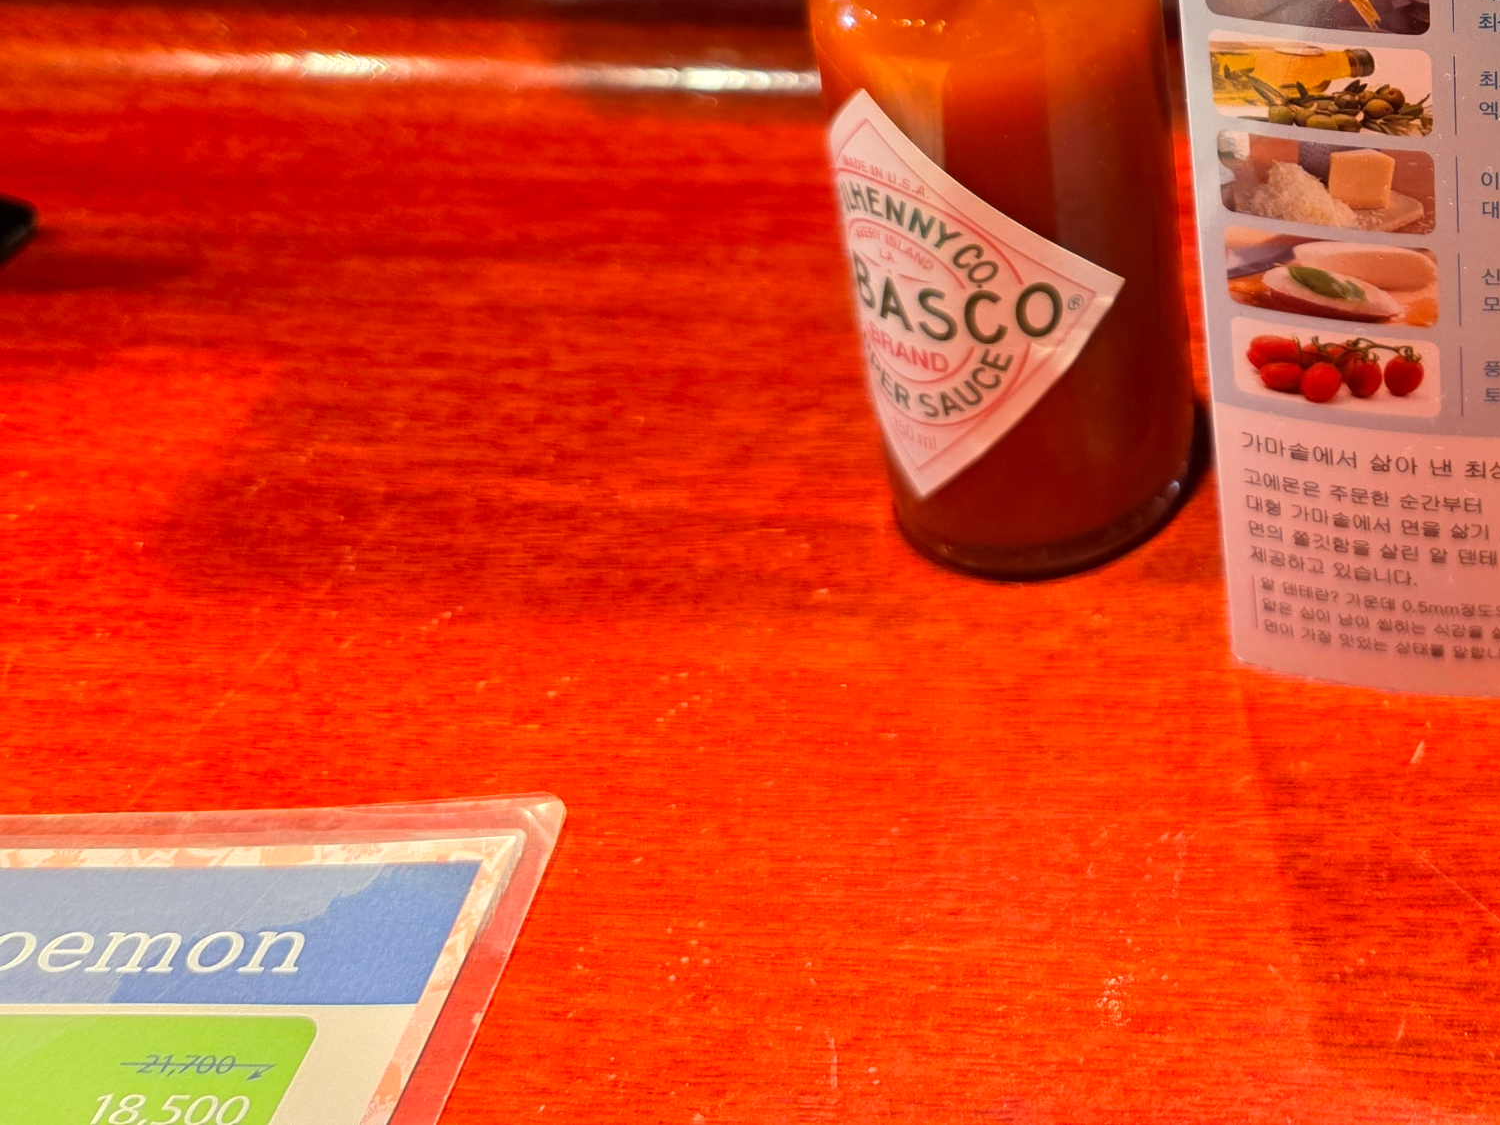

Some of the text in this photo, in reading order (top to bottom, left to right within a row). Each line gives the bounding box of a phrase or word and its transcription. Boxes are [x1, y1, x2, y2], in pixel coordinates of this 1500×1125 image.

[887, 171, 930, 200] U.S.A.
[952, 242, 999, 289] CO.
[869, 327, 951, 374] BRAND
[918, 347, 1014, 419] SAUCE
[1242, 432, 1357, 468] 가마솥에서
[1370, 454, 1418, 476] 삶아
[1430, 459, 1452, 477] 낸
[1245, 468, 1482, 514] 고에몬은 주문한 순간부터
[1246, 495, 1281, 516] 대형
[1292, 504, 1390, 534] 가마솥에서
[1401, 520, 1440, 538] 면을
[1450, 524, 1489, 541] 삶기
[1248, 520, 1283, 542] 면의
[1293, 530, 1370, 559] 쫄깃함을
[1380, 544, 1418, 561] 살린
[1430, 548, 1447, 566] 알
[1458, 549, 1498, 568] 덴테
[1250, 543, 1417, 587] 제공하고 있습니다.
[90, 1093, 251, 1125] 18,500
